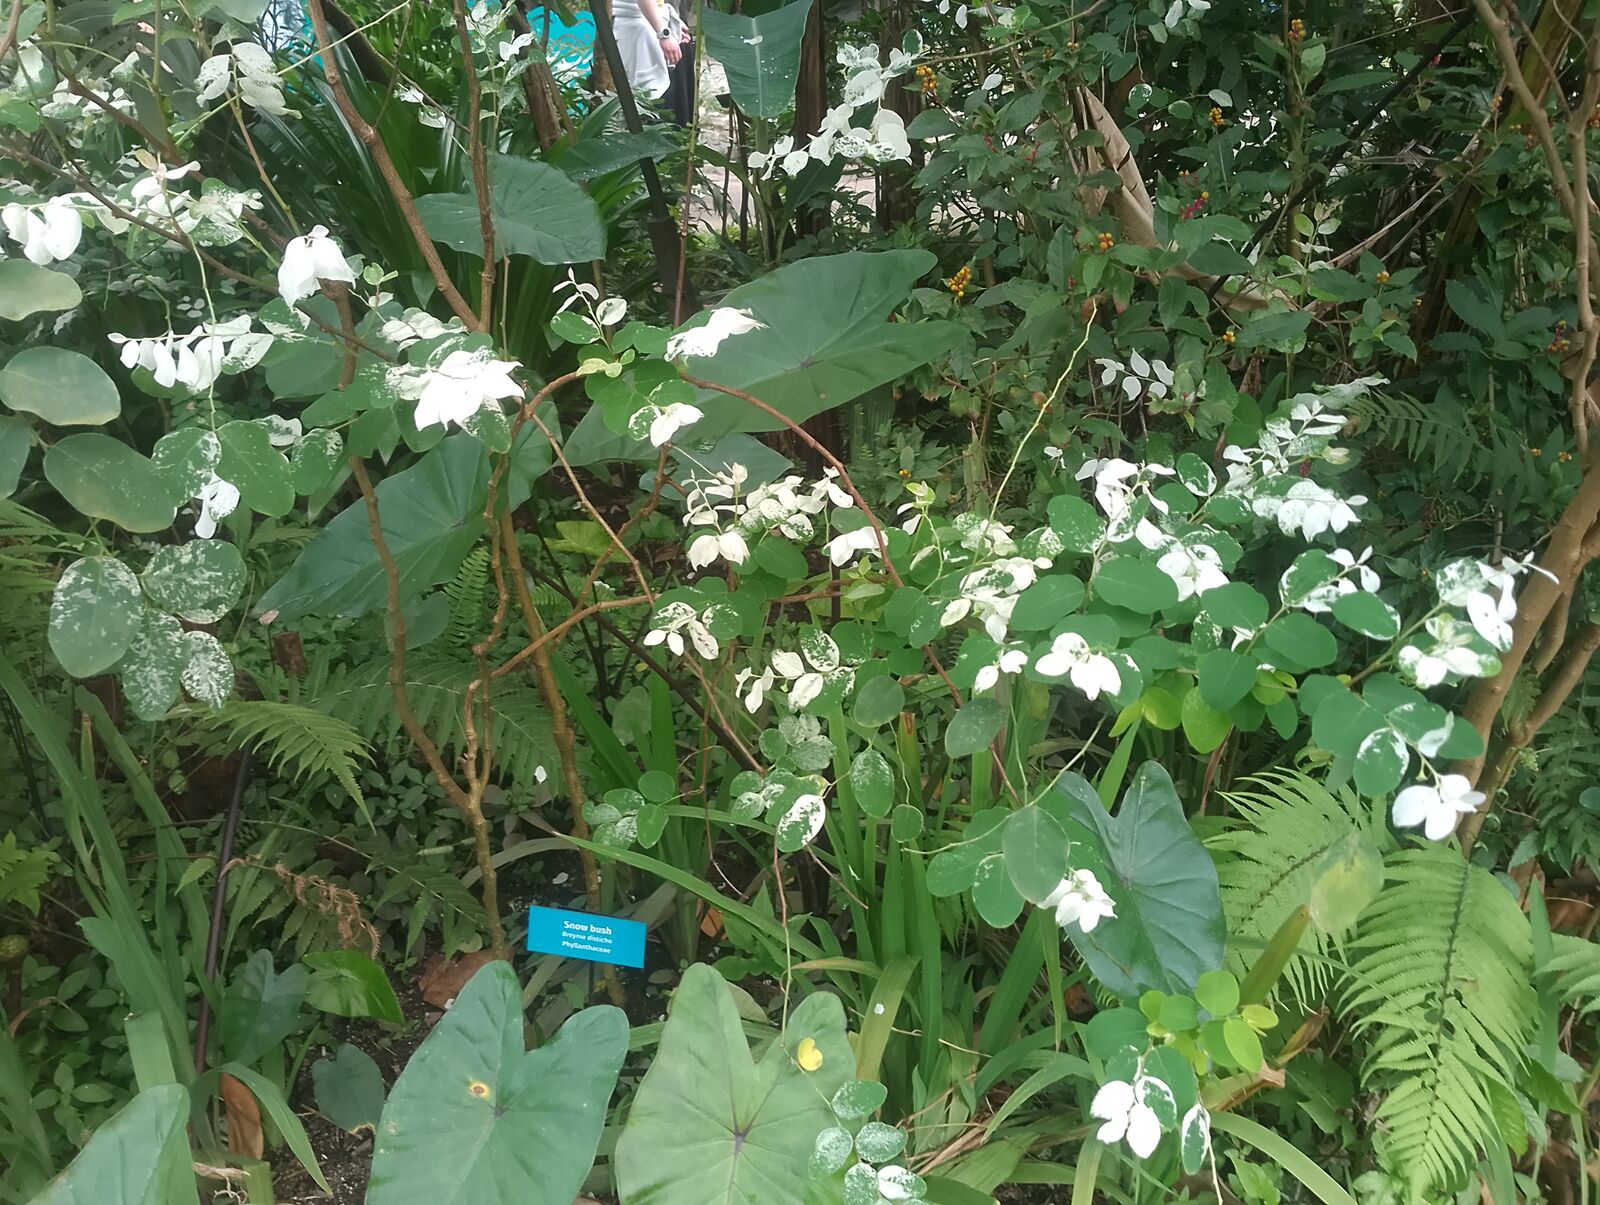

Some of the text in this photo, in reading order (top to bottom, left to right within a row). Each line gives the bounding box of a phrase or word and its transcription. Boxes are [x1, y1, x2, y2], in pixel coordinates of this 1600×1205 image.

[563, 920, 612, 935] Snow bush
[562, 940, 611, 953] Phyllanthaceae
